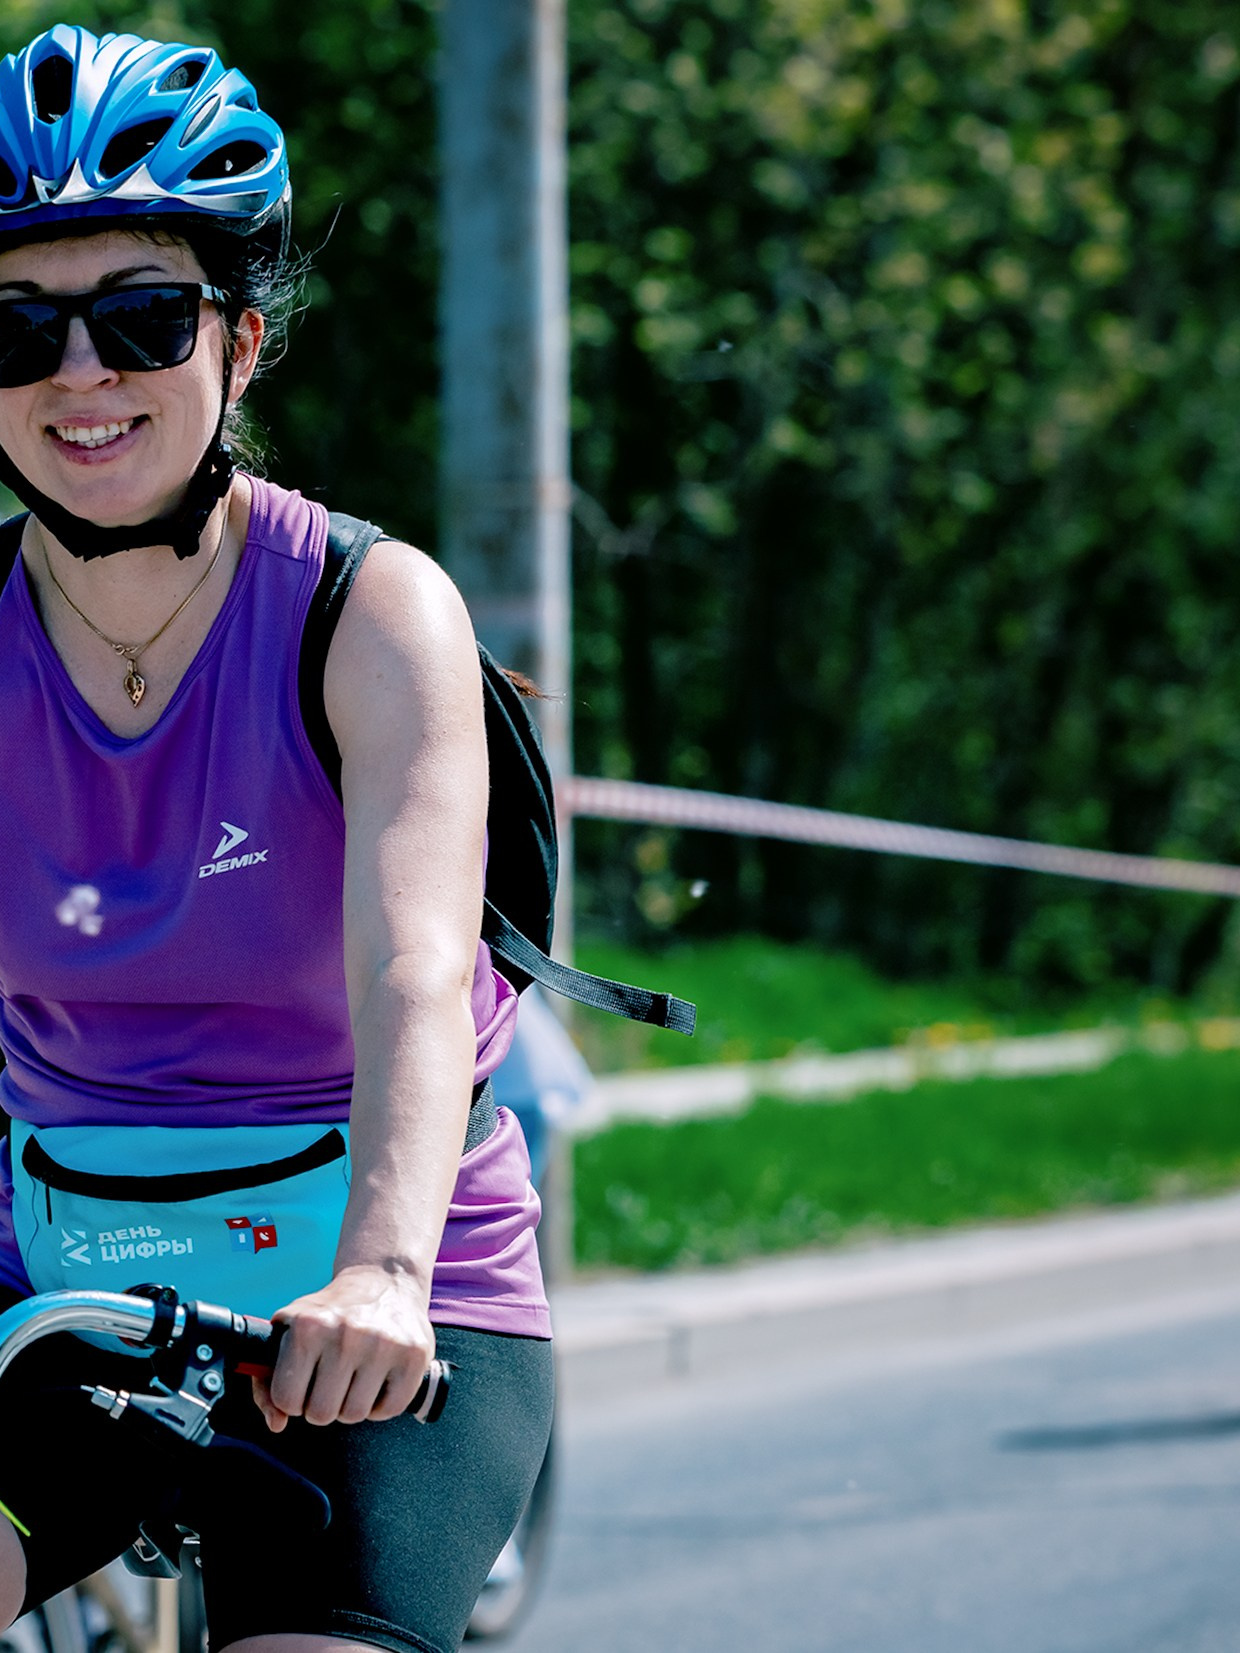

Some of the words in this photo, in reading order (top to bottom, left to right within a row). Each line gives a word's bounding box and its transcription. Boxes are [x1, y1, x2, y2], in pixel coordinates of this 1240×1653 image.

[198, 849, 269, 879] DEMIX
[97, 1225, 162, 1245] ДЕНЬ
[101, 1237, 194, 1264] ЦИФРЫ
